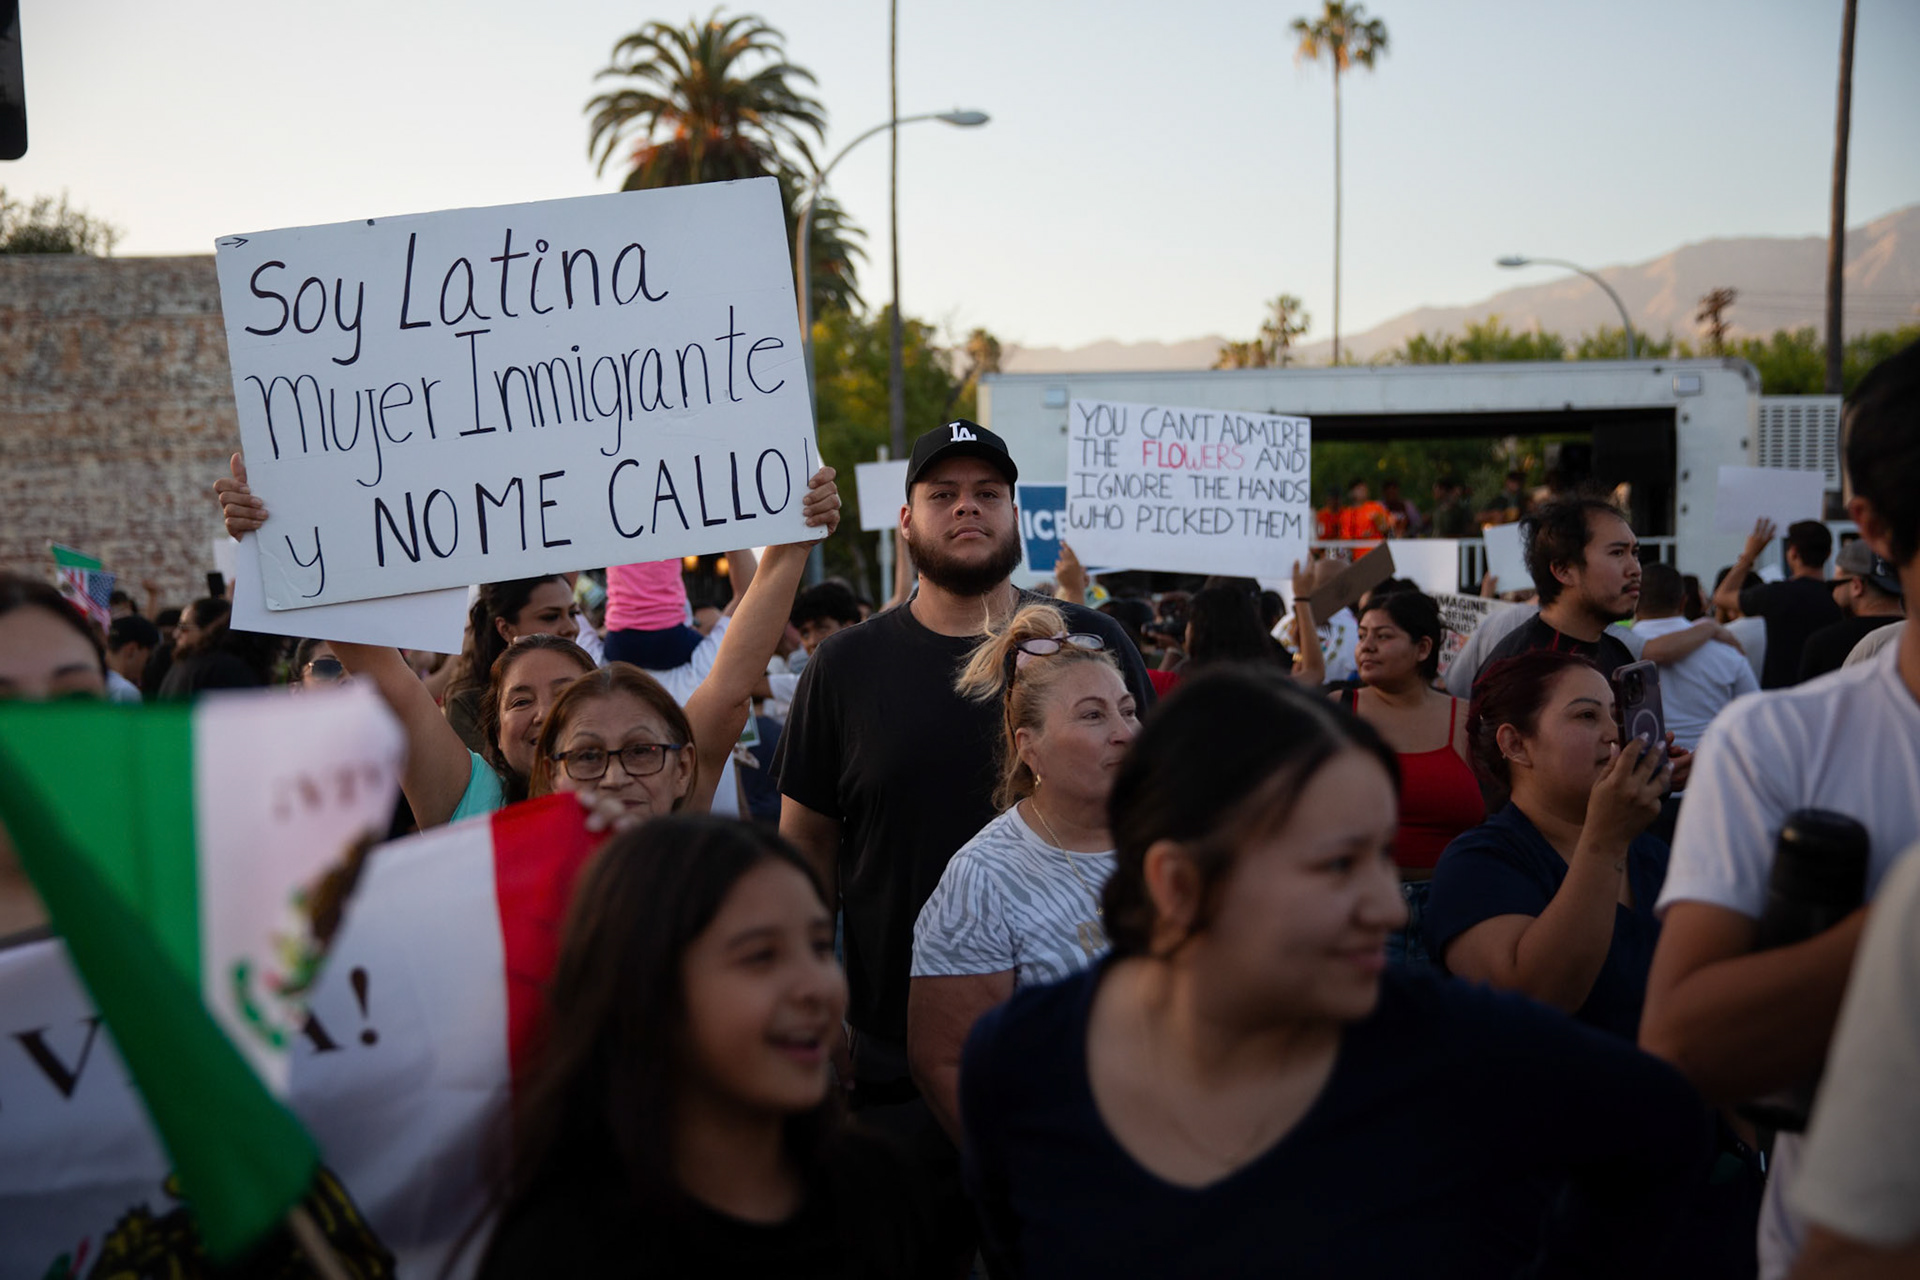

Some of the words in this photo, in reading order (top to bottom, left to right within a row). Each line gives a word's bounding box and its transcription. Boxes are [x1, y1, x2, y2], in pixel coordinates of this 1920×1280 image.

[245, 260, 364, 366] Soy
[399, 228, 669, 330] Latina
[454, 305, 785, 457] Inmigrante
[948, 422, 978, 442] LA
[1076, 402, 1127, 437] YOU
[1219, 414, 1308, 453] ADMIRE
[1073, 436, 1119, 468] THE
[1142, 439, 1245, 471] FLOWERS
[1254, 447, 1306, 473] AND
[1072, 472, 1172, 500] IGNORE
[1188, 474, 1231, 500] THE
[1237, 476, 1308, 503] HANDS
[1022, 509, 1067, 541] ICE
[1069, 502, 1124, 530] WHO
[1135, 504, 1235, 535] PICKED
[1236, 507, 1302, 540] THEM
[284, 526, 326, 598] y
